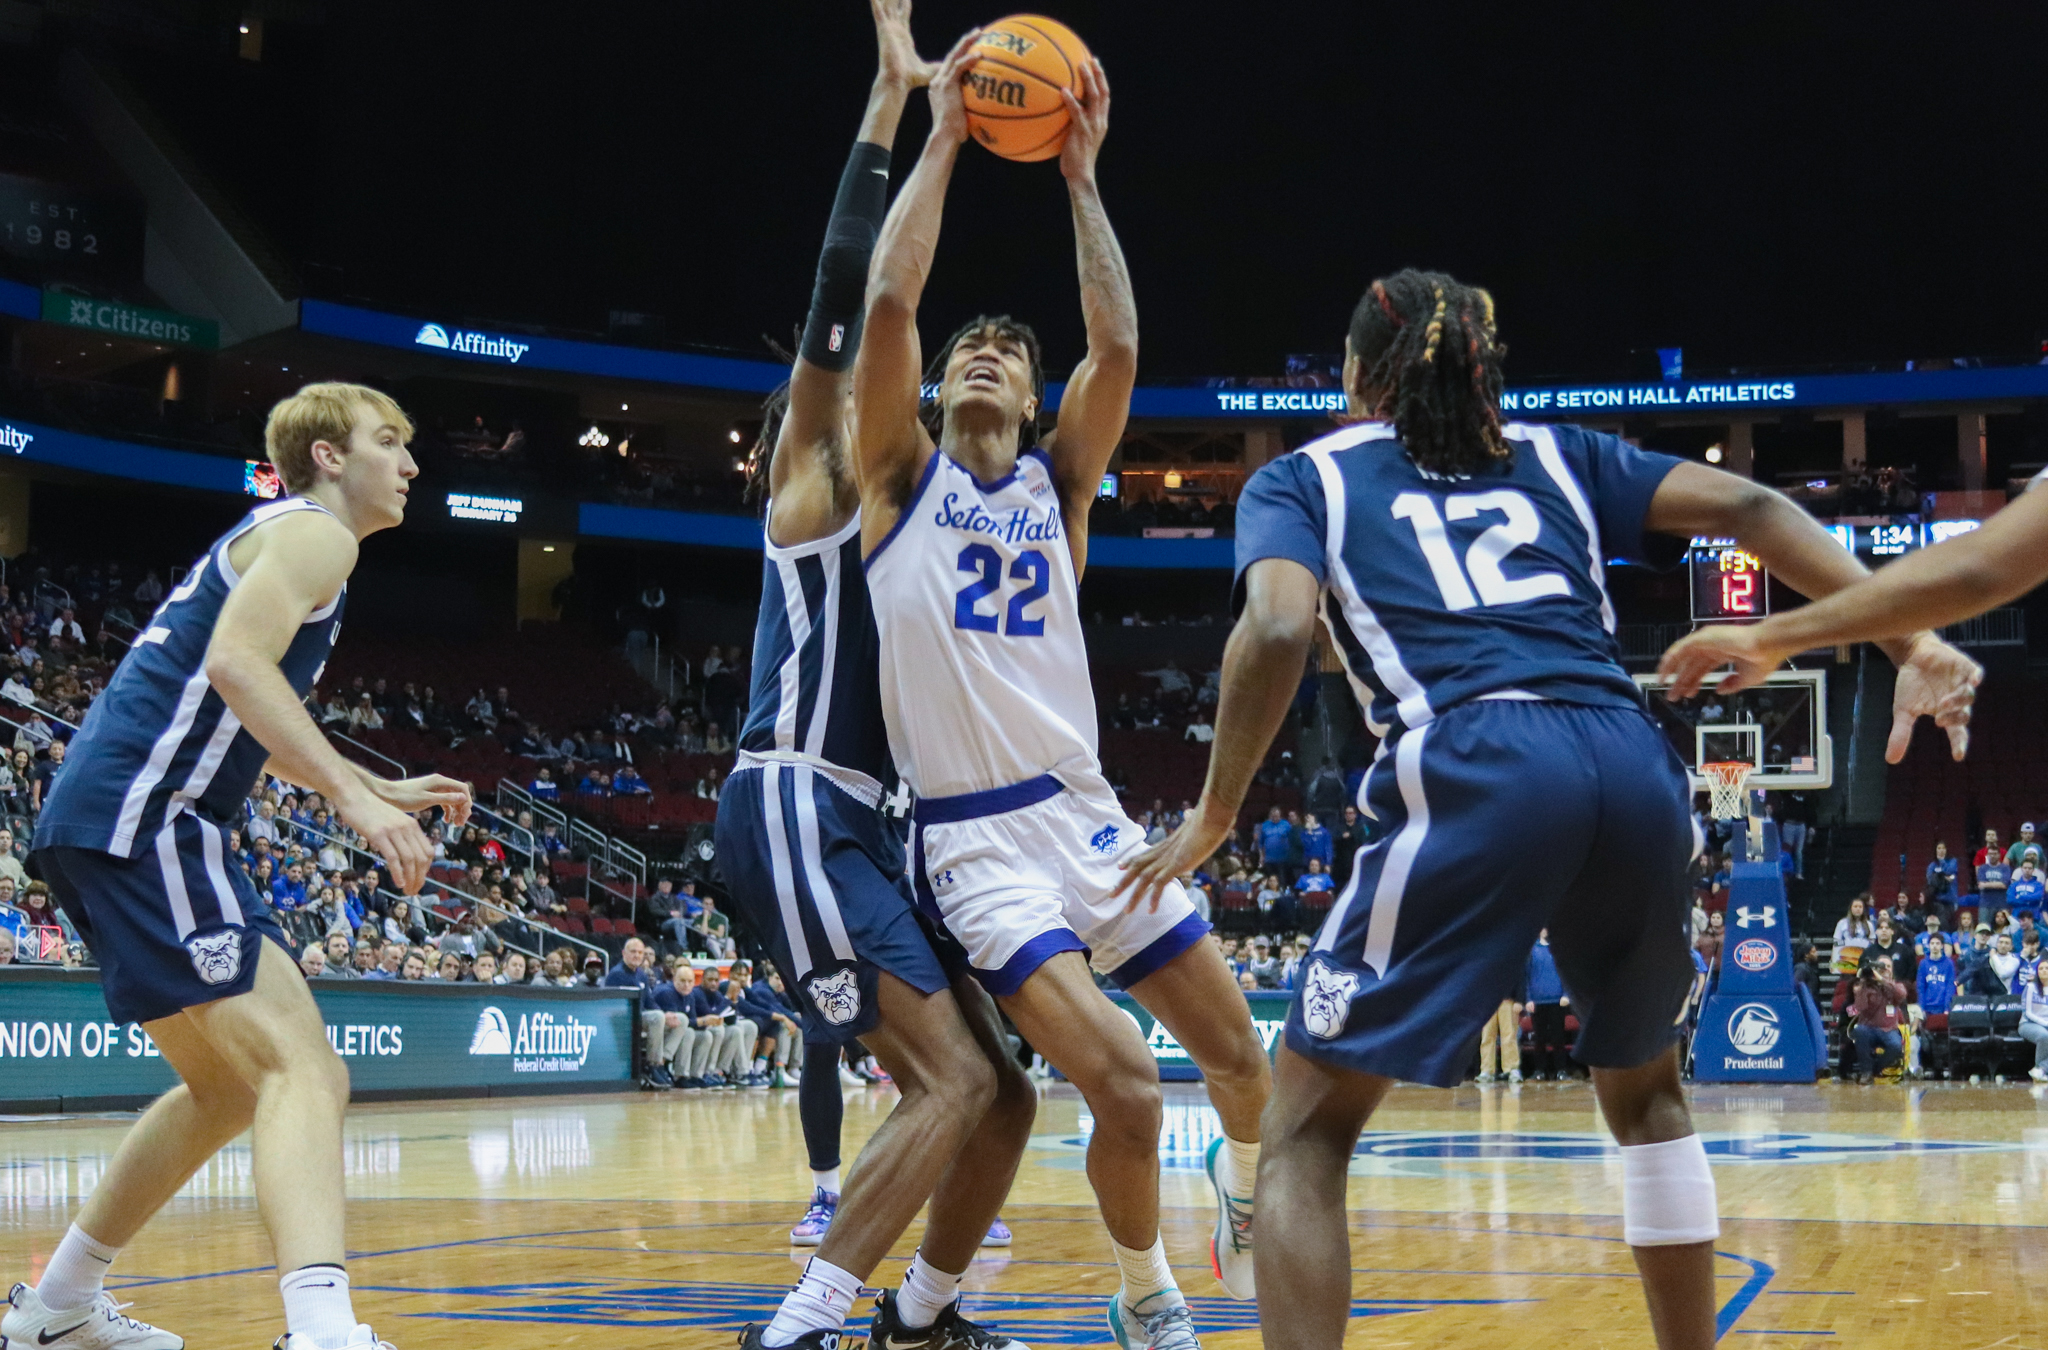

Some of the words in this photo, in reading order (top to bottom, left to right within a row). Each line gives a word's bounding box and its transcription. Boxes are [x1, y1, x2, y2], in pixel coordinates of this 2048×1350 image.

[6, 222, 98, 254] 1982
[96, 306, 191, 342] Citizens
[451, 331, 525, 363] Affinity
[1217, 393, 1258, 411] THE
[1523, 393, 1553, 410] OF
[1556, 389, 1623, 408] SETON
[1628, 387, 1681, 406] HALL
[1686, 383, 1796, 403] ATHLETICS
[935, 492, 1003, 540] Seton
[1005, 505, 1061, 545] Hall
[1390, 489, 1573, 612] 12
[1870, 525, 1914, 546] 1:34
[1719, 550, 1760, 573] 1:34
[955, 542, 1050, 638] 22
[1721, 573, 1754, 612] 12
[81, 1022, 120, 1058] OF
[514, 1012, 593, 1066] Affinity
[514, 1057, 539, 1073] Federal
[539, 1058, 559, 1072] Credit
[559, 1058, 579, 1072] Union
[1724, 1056, 1784, 1069] Prudential
